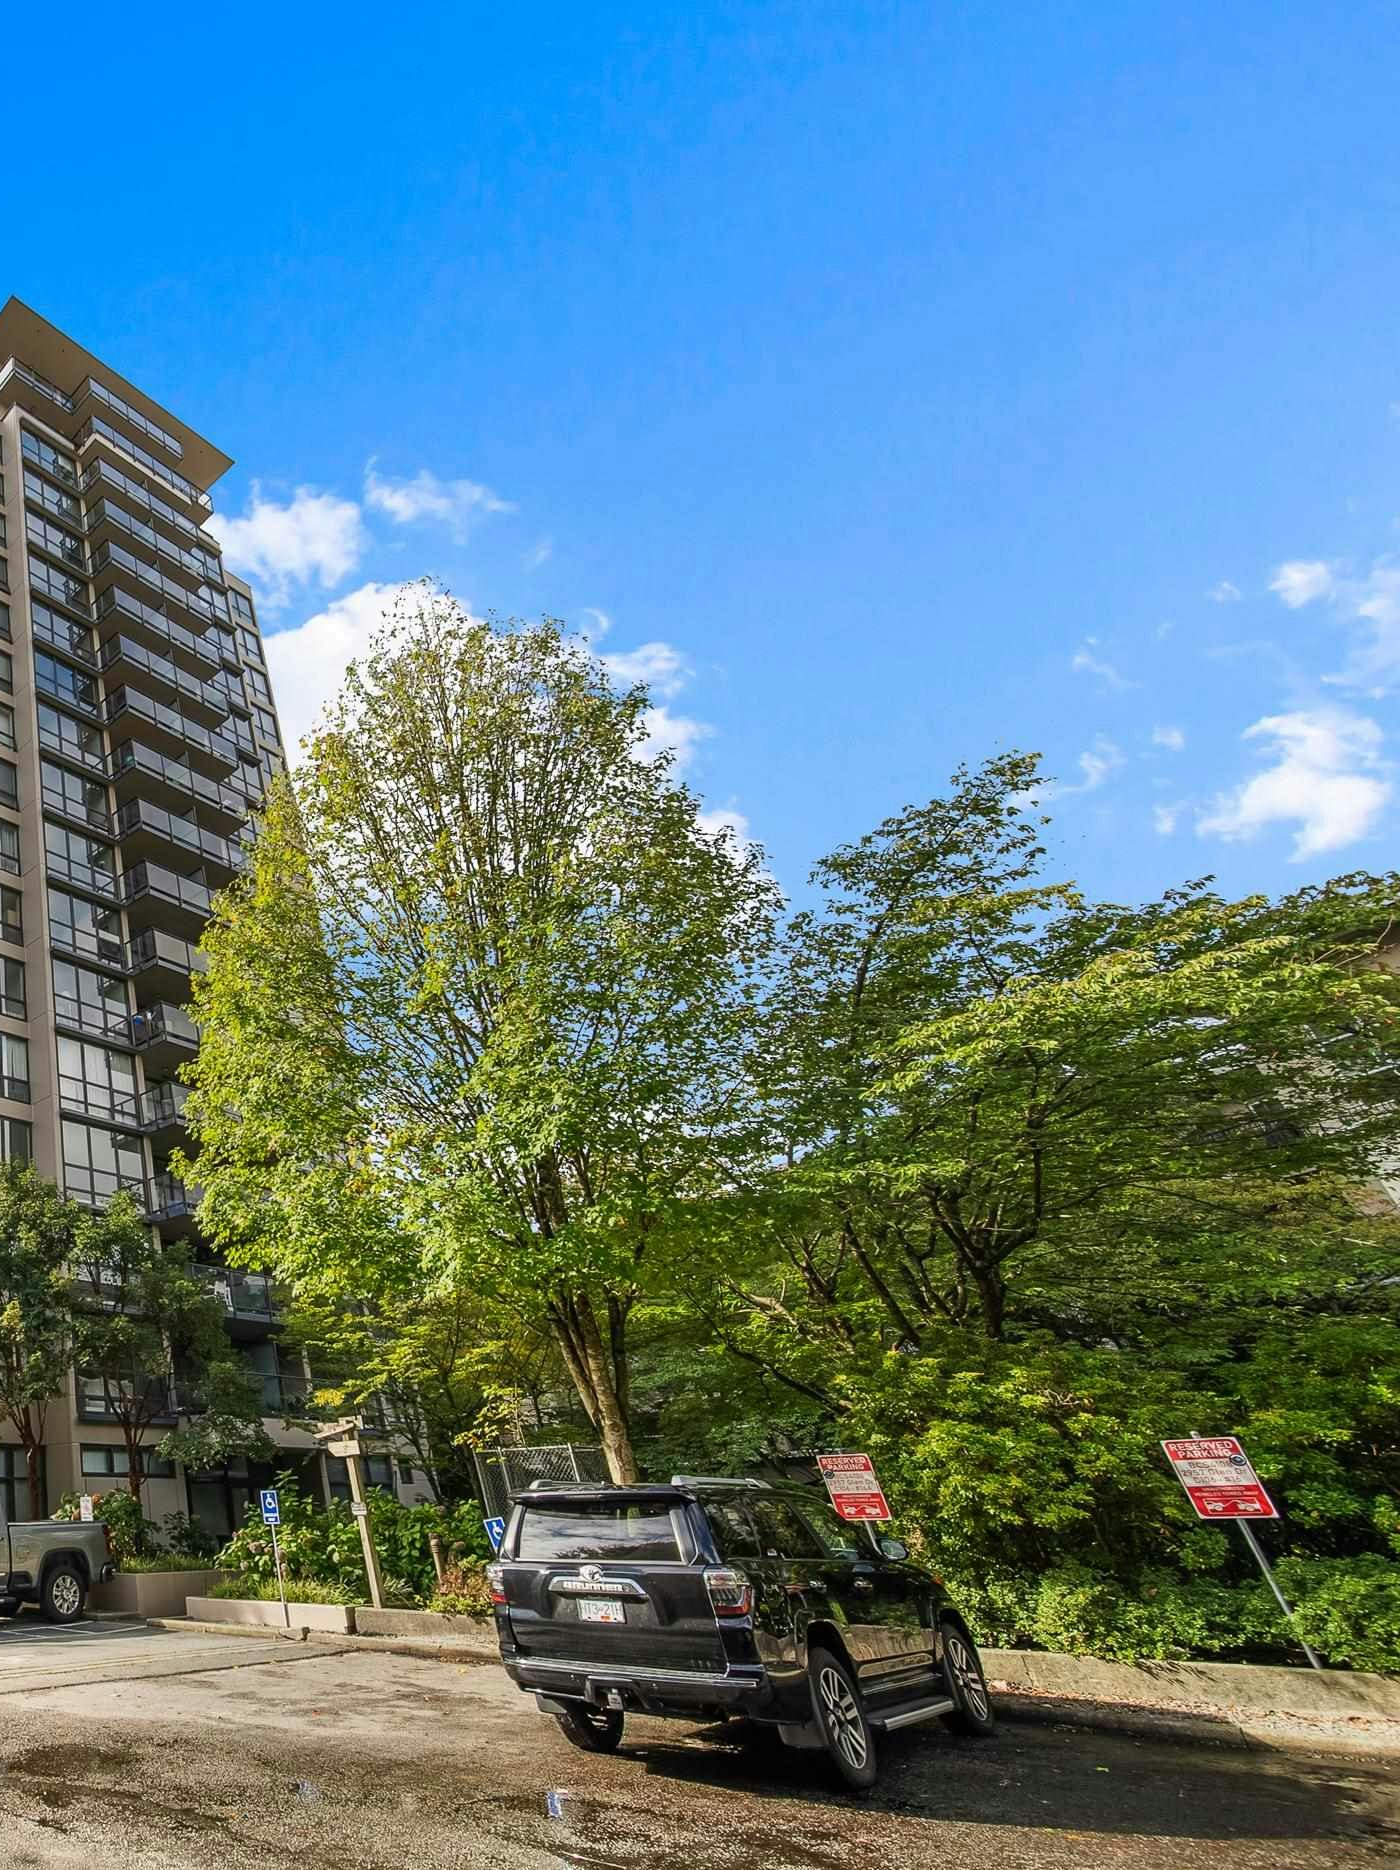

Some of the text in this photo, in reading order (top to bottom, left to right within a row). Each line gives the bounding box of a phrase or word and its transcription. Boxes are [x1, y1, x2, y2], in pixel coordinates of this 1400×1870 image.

[1168, 1441, 1232, 1451] RESERVED
[1177, 1449, 1232, 1459] PARKING
[821, 1457, 866, 1465] RESERVED
[826, 1463, 864, 1471] PARKING
